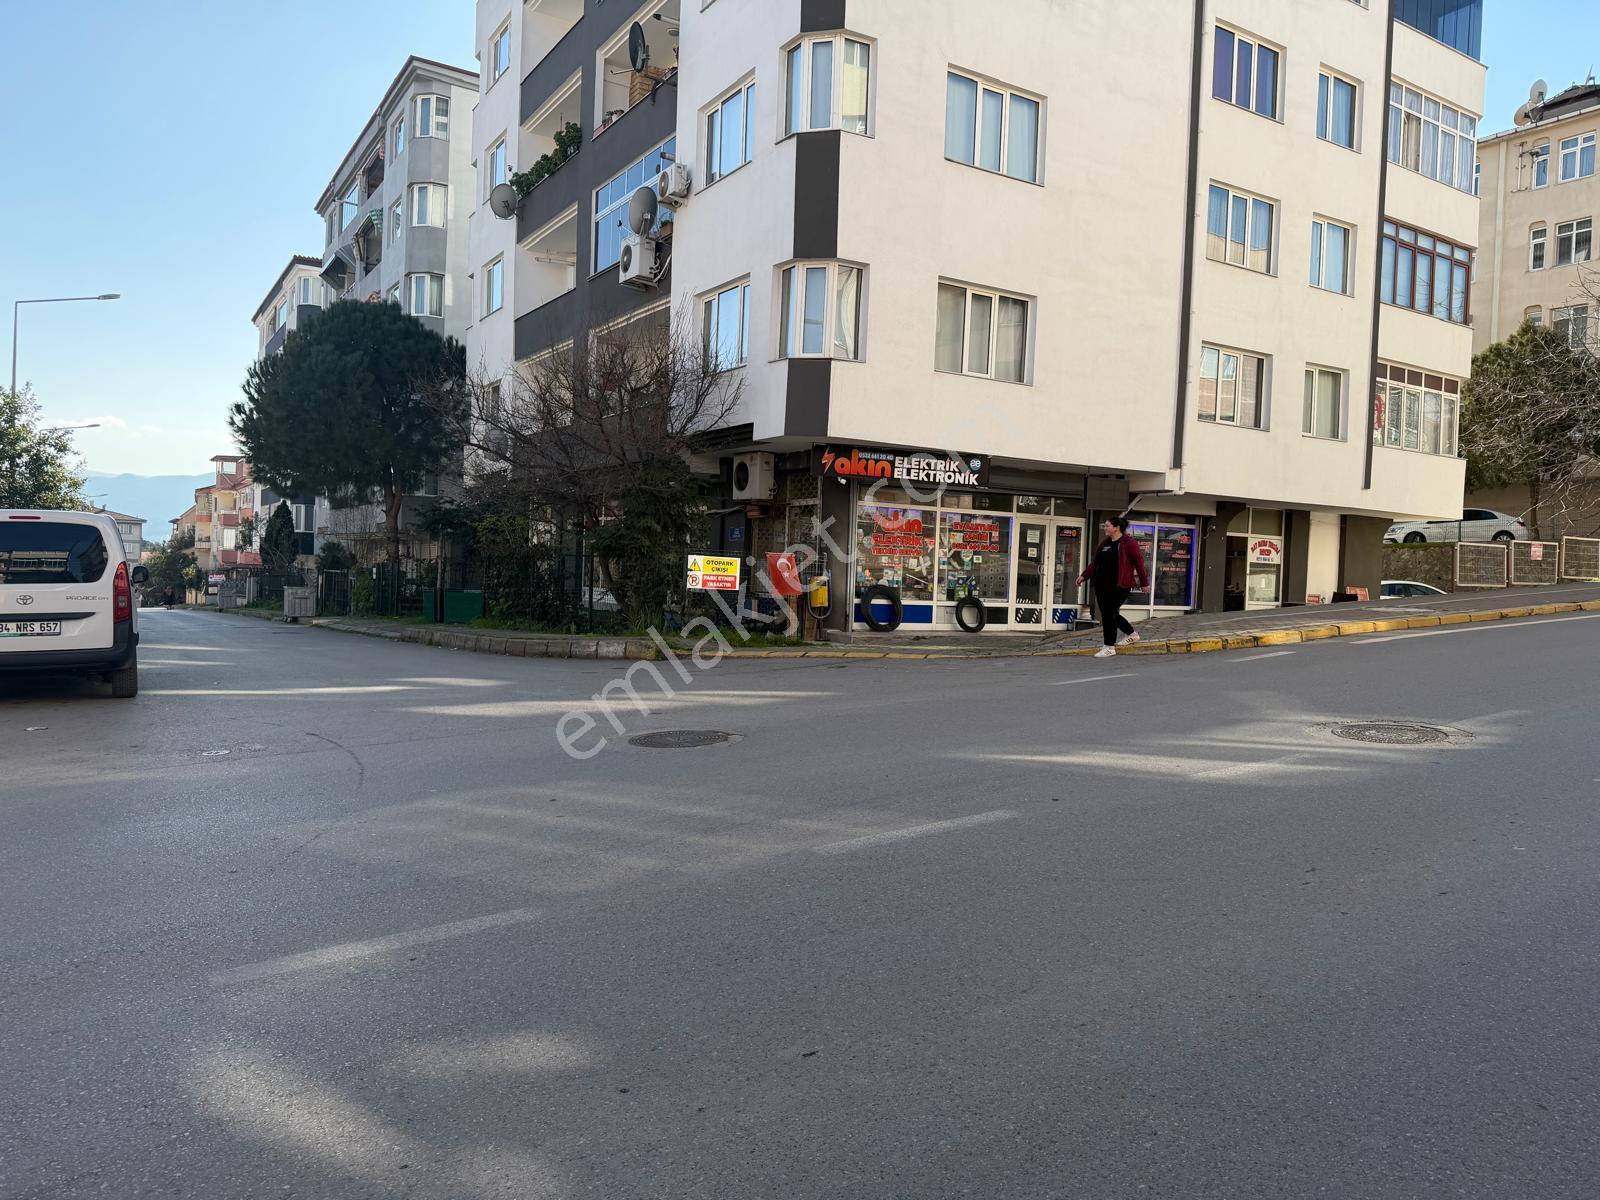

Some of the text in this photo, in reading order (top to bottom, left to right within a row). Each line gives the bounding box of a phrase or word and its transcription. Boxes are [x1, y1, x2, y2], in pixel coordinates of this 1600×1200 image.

[834, 449, 892, 478] akın
[895, 456, 960, 472] ELEKTRİK
[893, 467, 979, 486] ELEKTRONİK
[15, 622, 35, 633] NRS
[39, 622, 59, 632] 657
